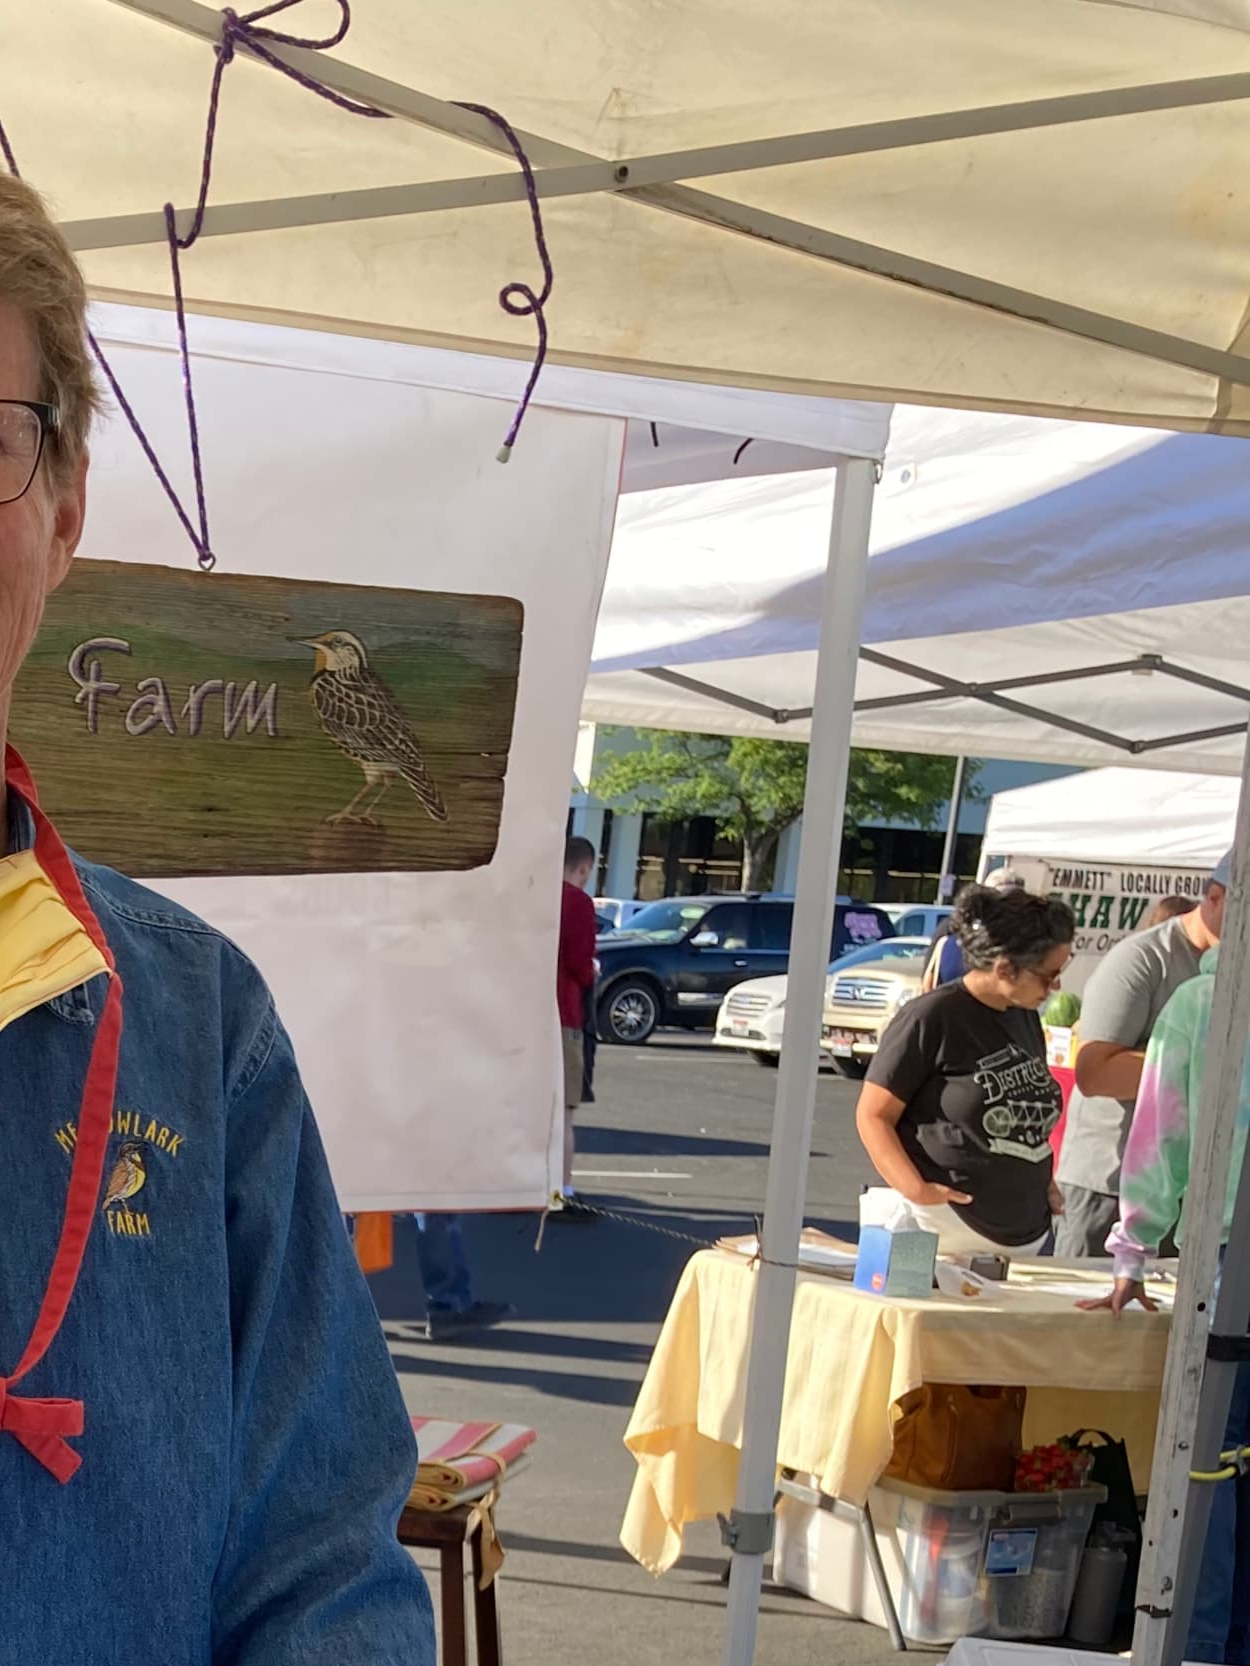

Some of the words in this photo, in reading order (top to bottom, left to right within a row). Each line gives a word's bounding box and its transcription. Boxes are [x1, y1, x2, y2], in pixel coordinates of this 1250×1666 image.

[68, 637, 278, 740] Farm
[1121, 872, 1172, 895] LOCALLY
[1049, 892, 1149, 930] HAW
[107, 1210, 150, 1237] FARM
